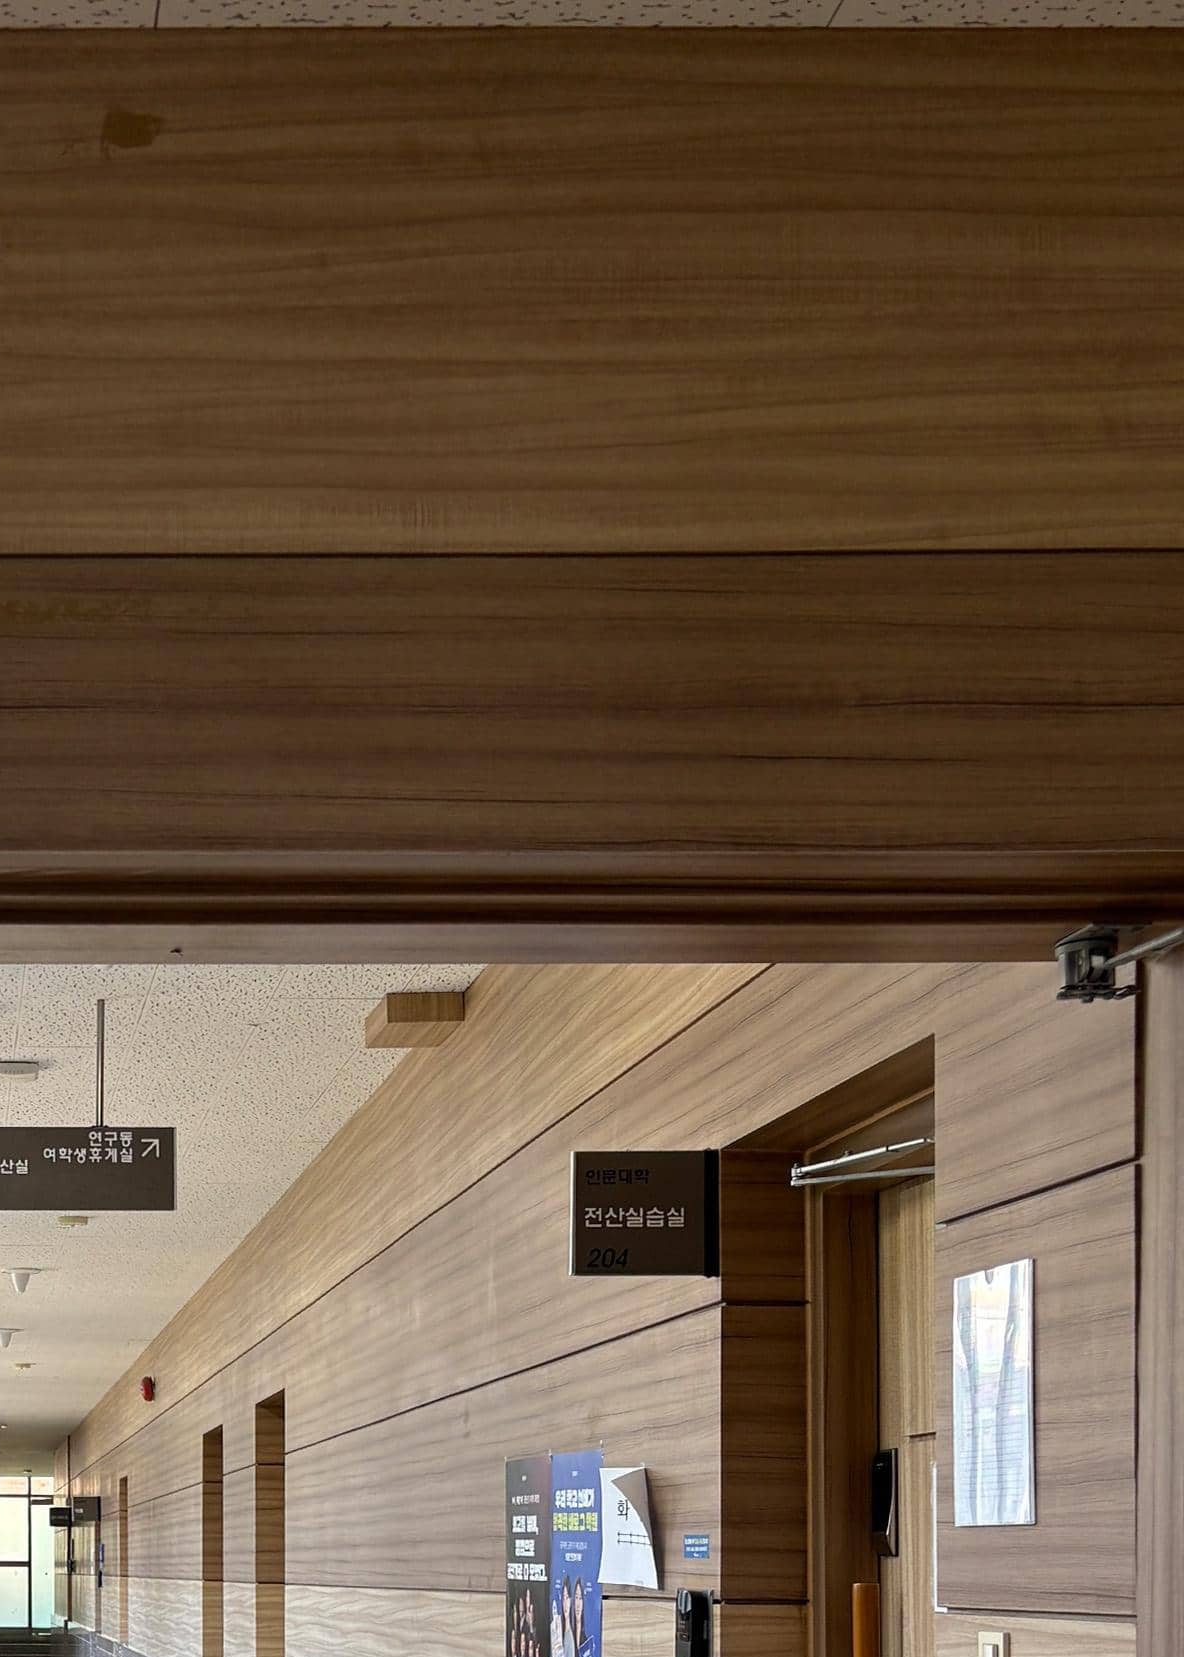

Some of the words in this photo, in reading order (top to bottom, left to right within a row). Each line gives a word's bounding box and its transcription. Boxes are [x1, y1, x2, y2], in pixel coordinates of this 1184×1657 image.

[88, 1131, 133, 1147] 연구동
[43, 1147, 133, 1164] 여학생휴게실
[585, 1168, 649, 1185] 인문대학
[584, 1206, 685, 1228] 전산실습실
[586, 1248, 629, 1269] 204
